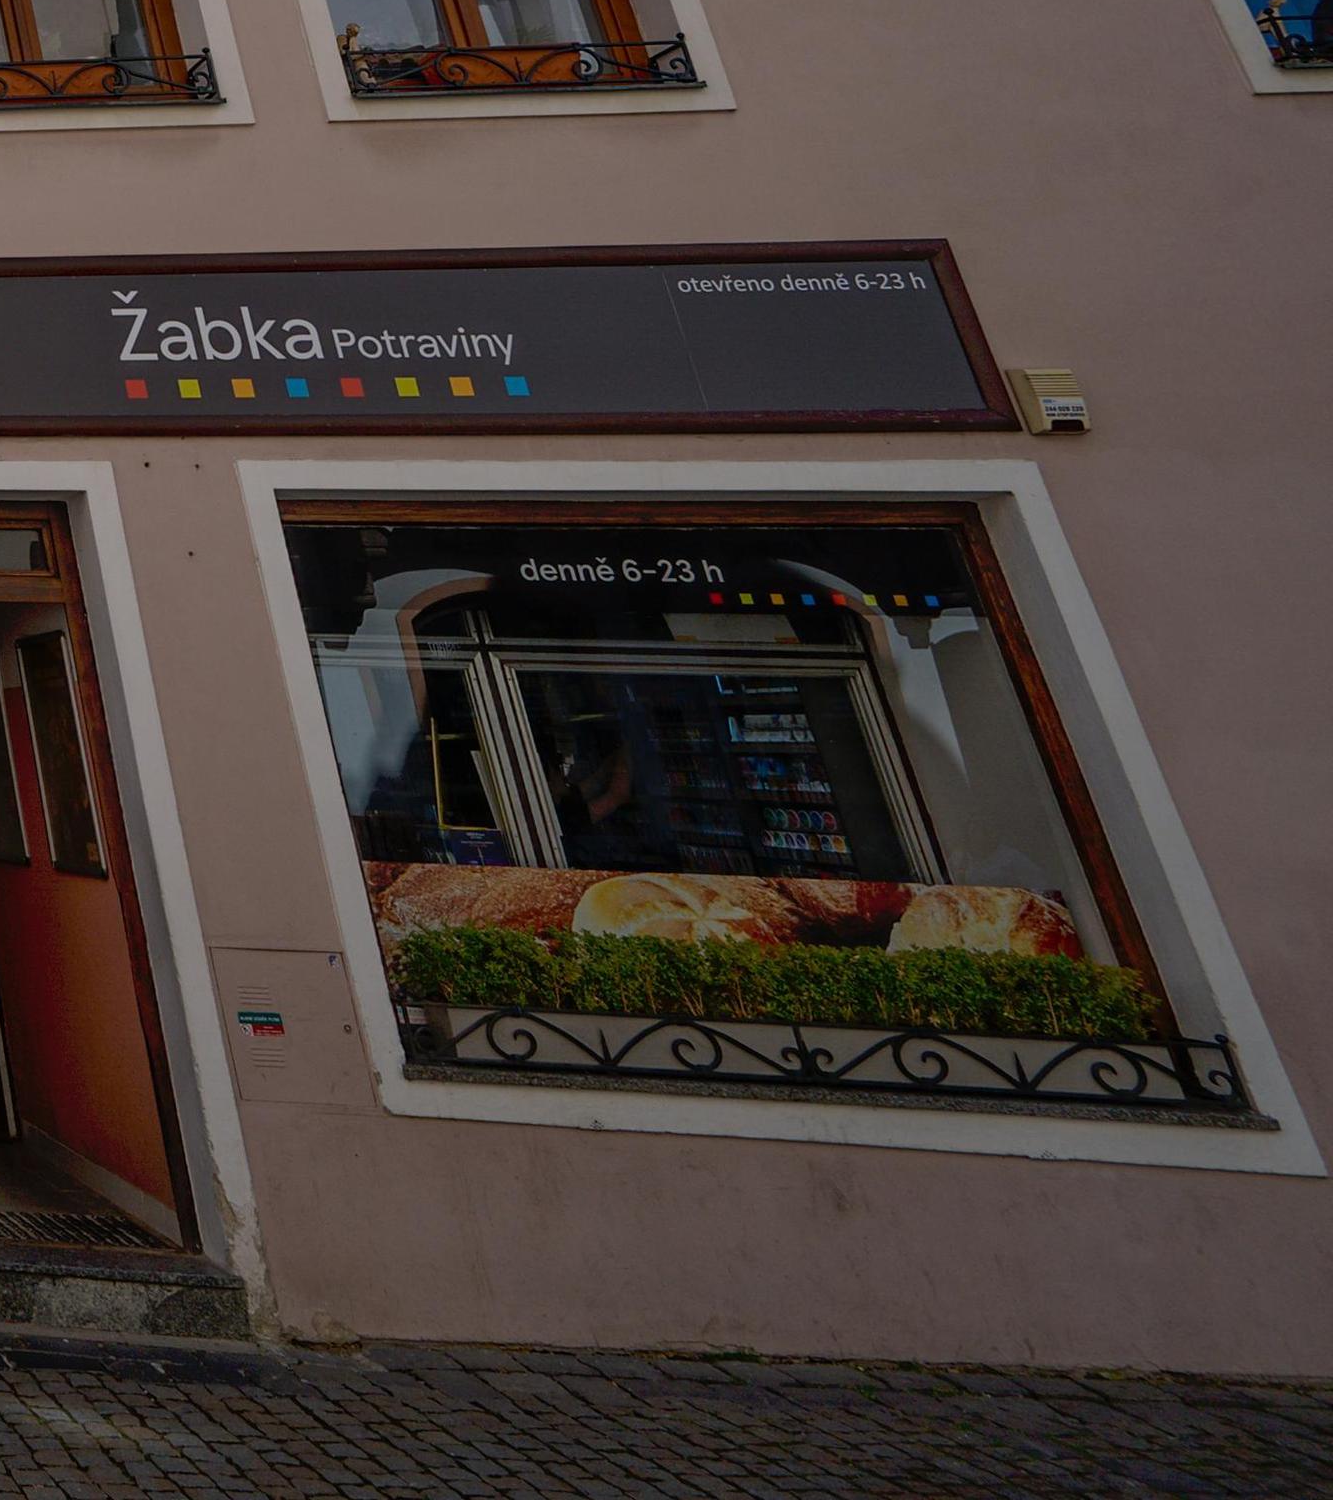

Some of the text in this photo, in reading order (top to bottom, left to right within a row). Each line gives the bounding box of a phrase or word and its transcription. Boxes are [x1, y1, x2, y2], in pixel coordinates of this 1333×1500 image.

[676, 271, 926, 294] otevřeno denně 6-23 h
[110, 289, 514, 366] Žabka Potraviny
[519, 556, 725, 583] denně 6-23 h
